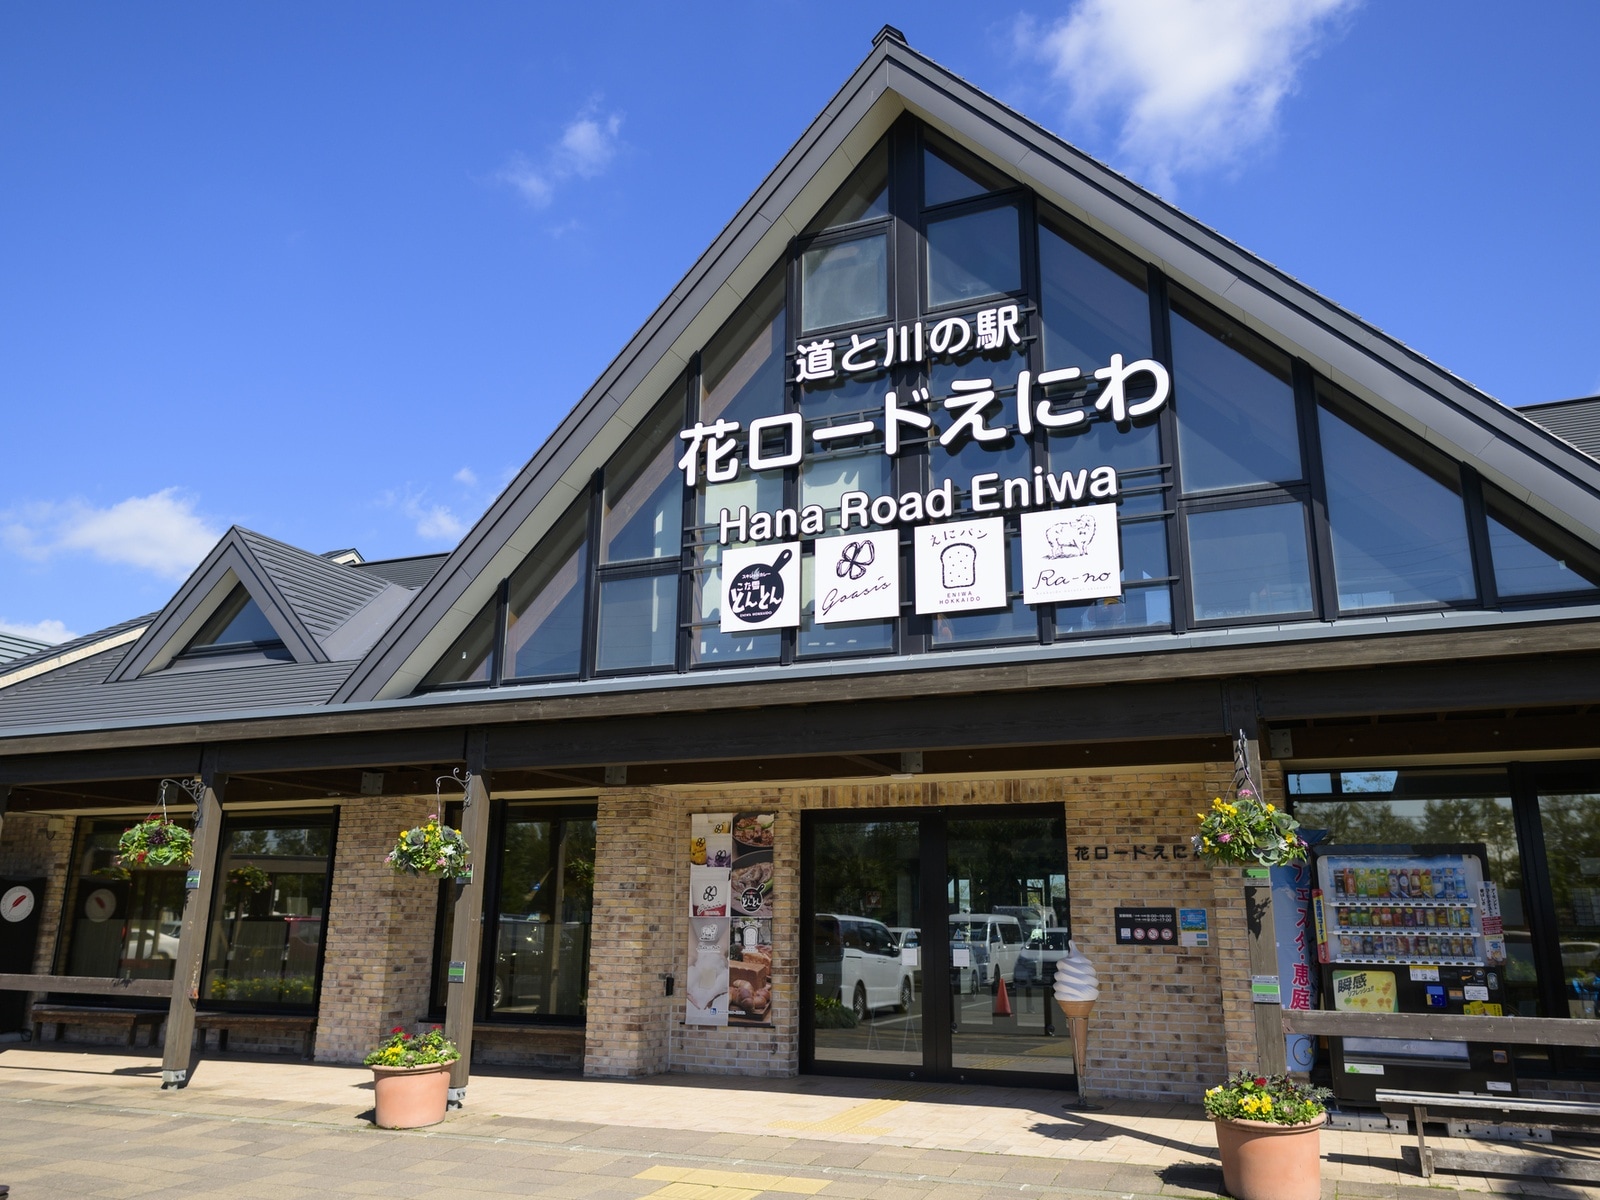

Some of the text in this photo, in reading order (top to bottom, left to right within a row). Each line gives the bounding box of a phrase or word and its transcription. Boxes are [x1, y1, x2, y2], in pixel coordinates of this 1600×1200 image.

[795, 304, 1021, 383] 道と川の駅
[678, 353, 1171, 488] 花ロードえにわ
[719, 464, 1118, 545] Hana Road Eniwa
[930, 528, 988, 547] えにパン
[1032, 569, 1111, 590] Ra-no
[939, 596, 981, 605] HOKKAIDO
[947, 590, 973, 598] ENIWA
[1074, 845, 1200, 861] 花ロードえに
[1337, 973, 1367, 993] 瞬感
